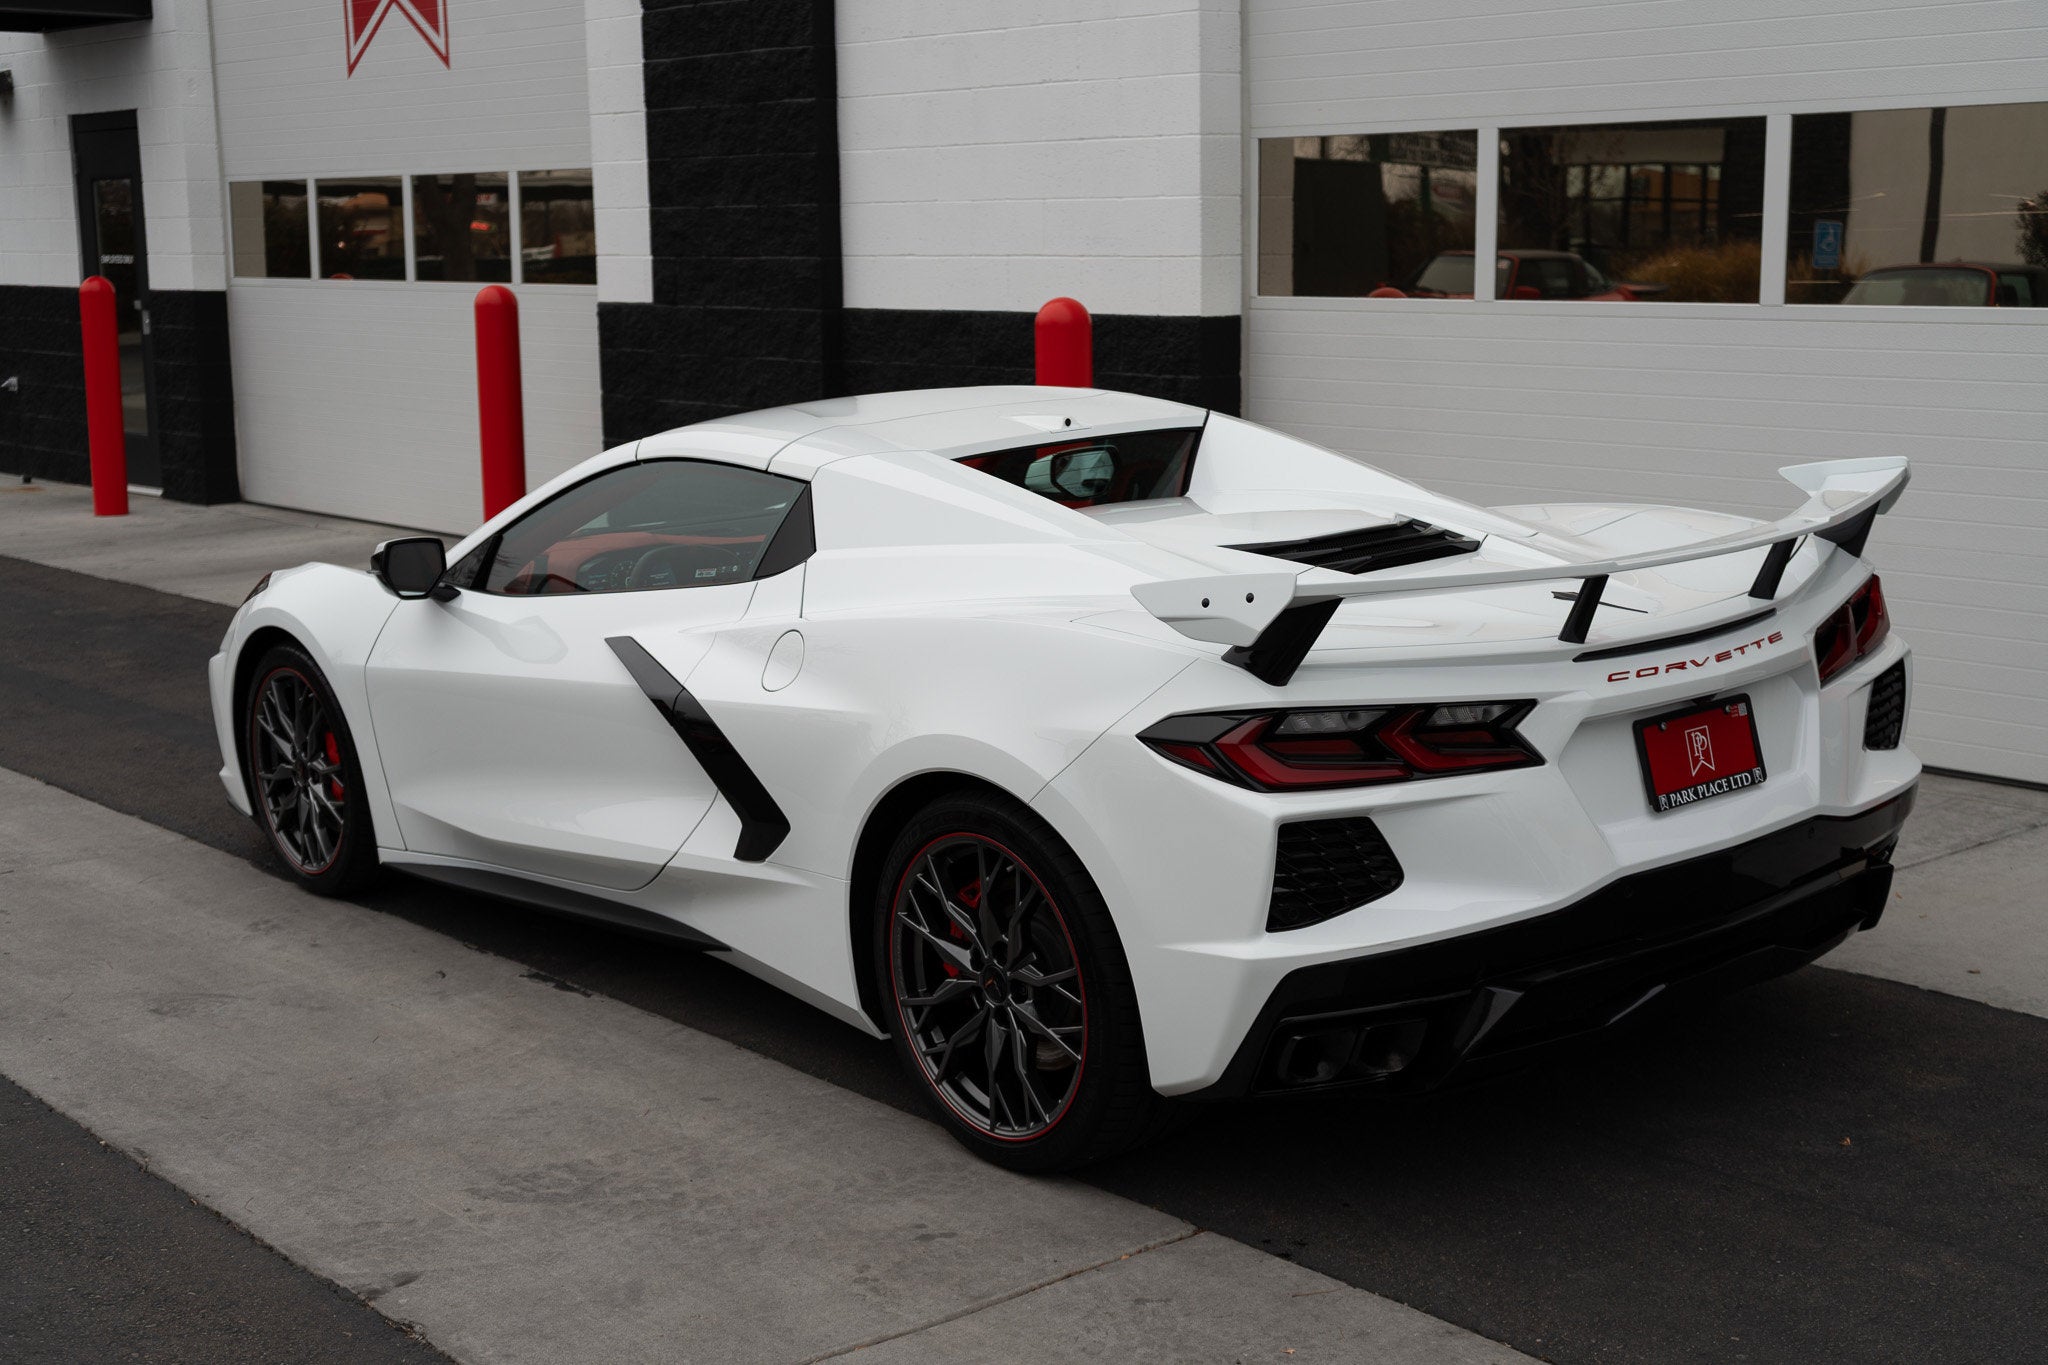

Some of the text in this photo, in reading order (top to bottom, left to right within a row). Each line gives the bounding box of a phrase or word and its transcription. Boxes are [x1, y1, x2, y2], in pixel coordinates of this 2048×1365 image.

[1607, 631, 1783, 682] CORVETTE
[1670, 788, 1698, 807] PARK
[1697, 779, 1730, 799] PLACE
[1729, 772, 1751, 789] LTD
